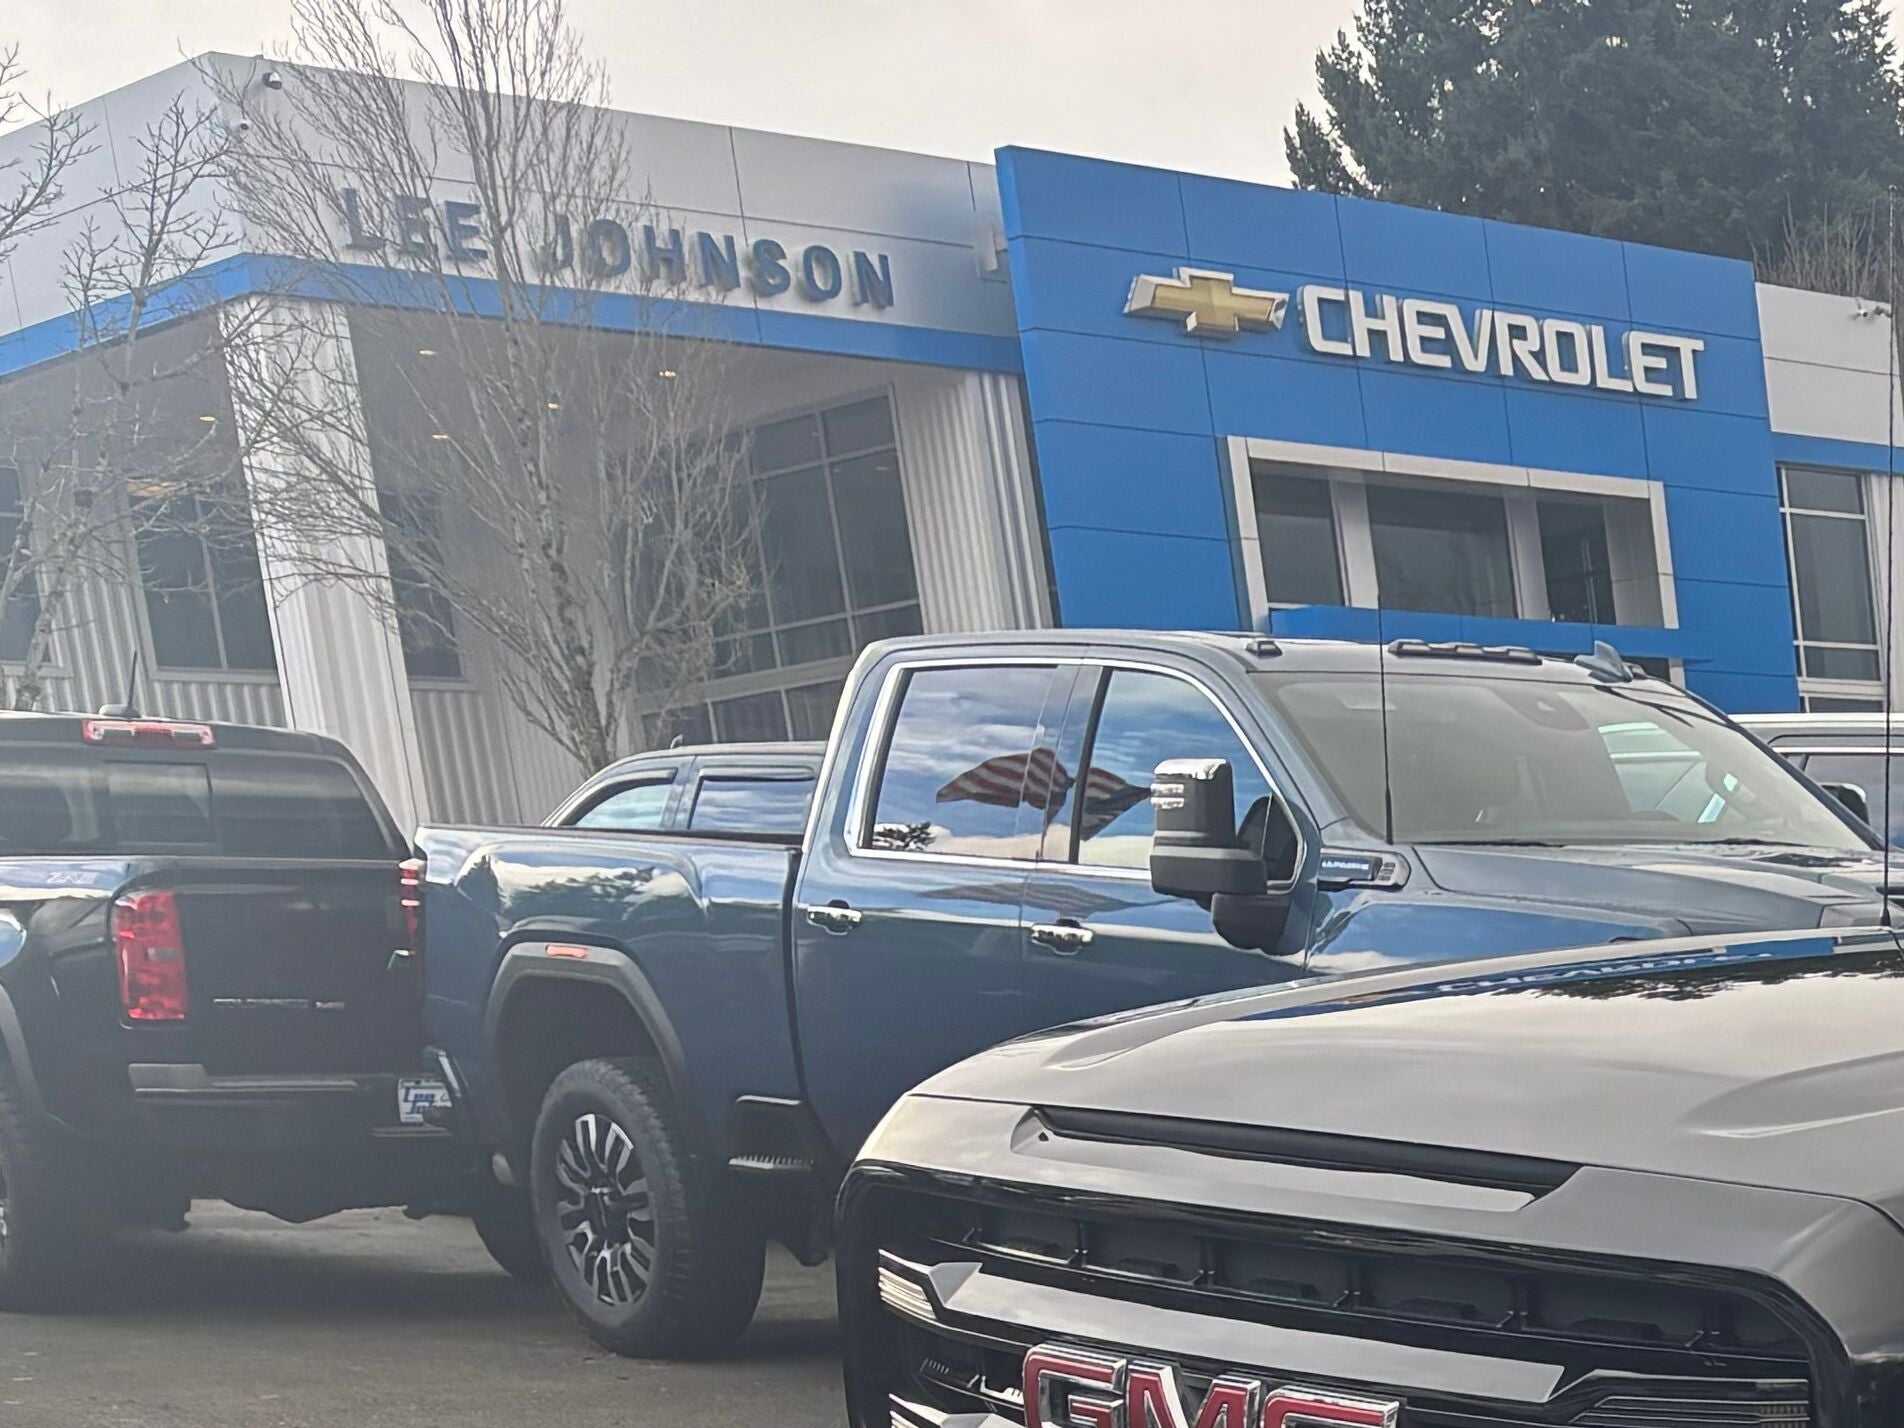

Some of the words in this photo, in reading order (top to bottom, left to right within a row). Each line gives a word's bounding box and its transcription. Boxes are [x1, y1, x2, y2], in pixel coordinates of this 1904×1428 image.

[342, 187, 490, 262] LEE
[540, 210, 895, 307] JOHNSON
[1299, 284, 1704, 400] CHEVROLET
